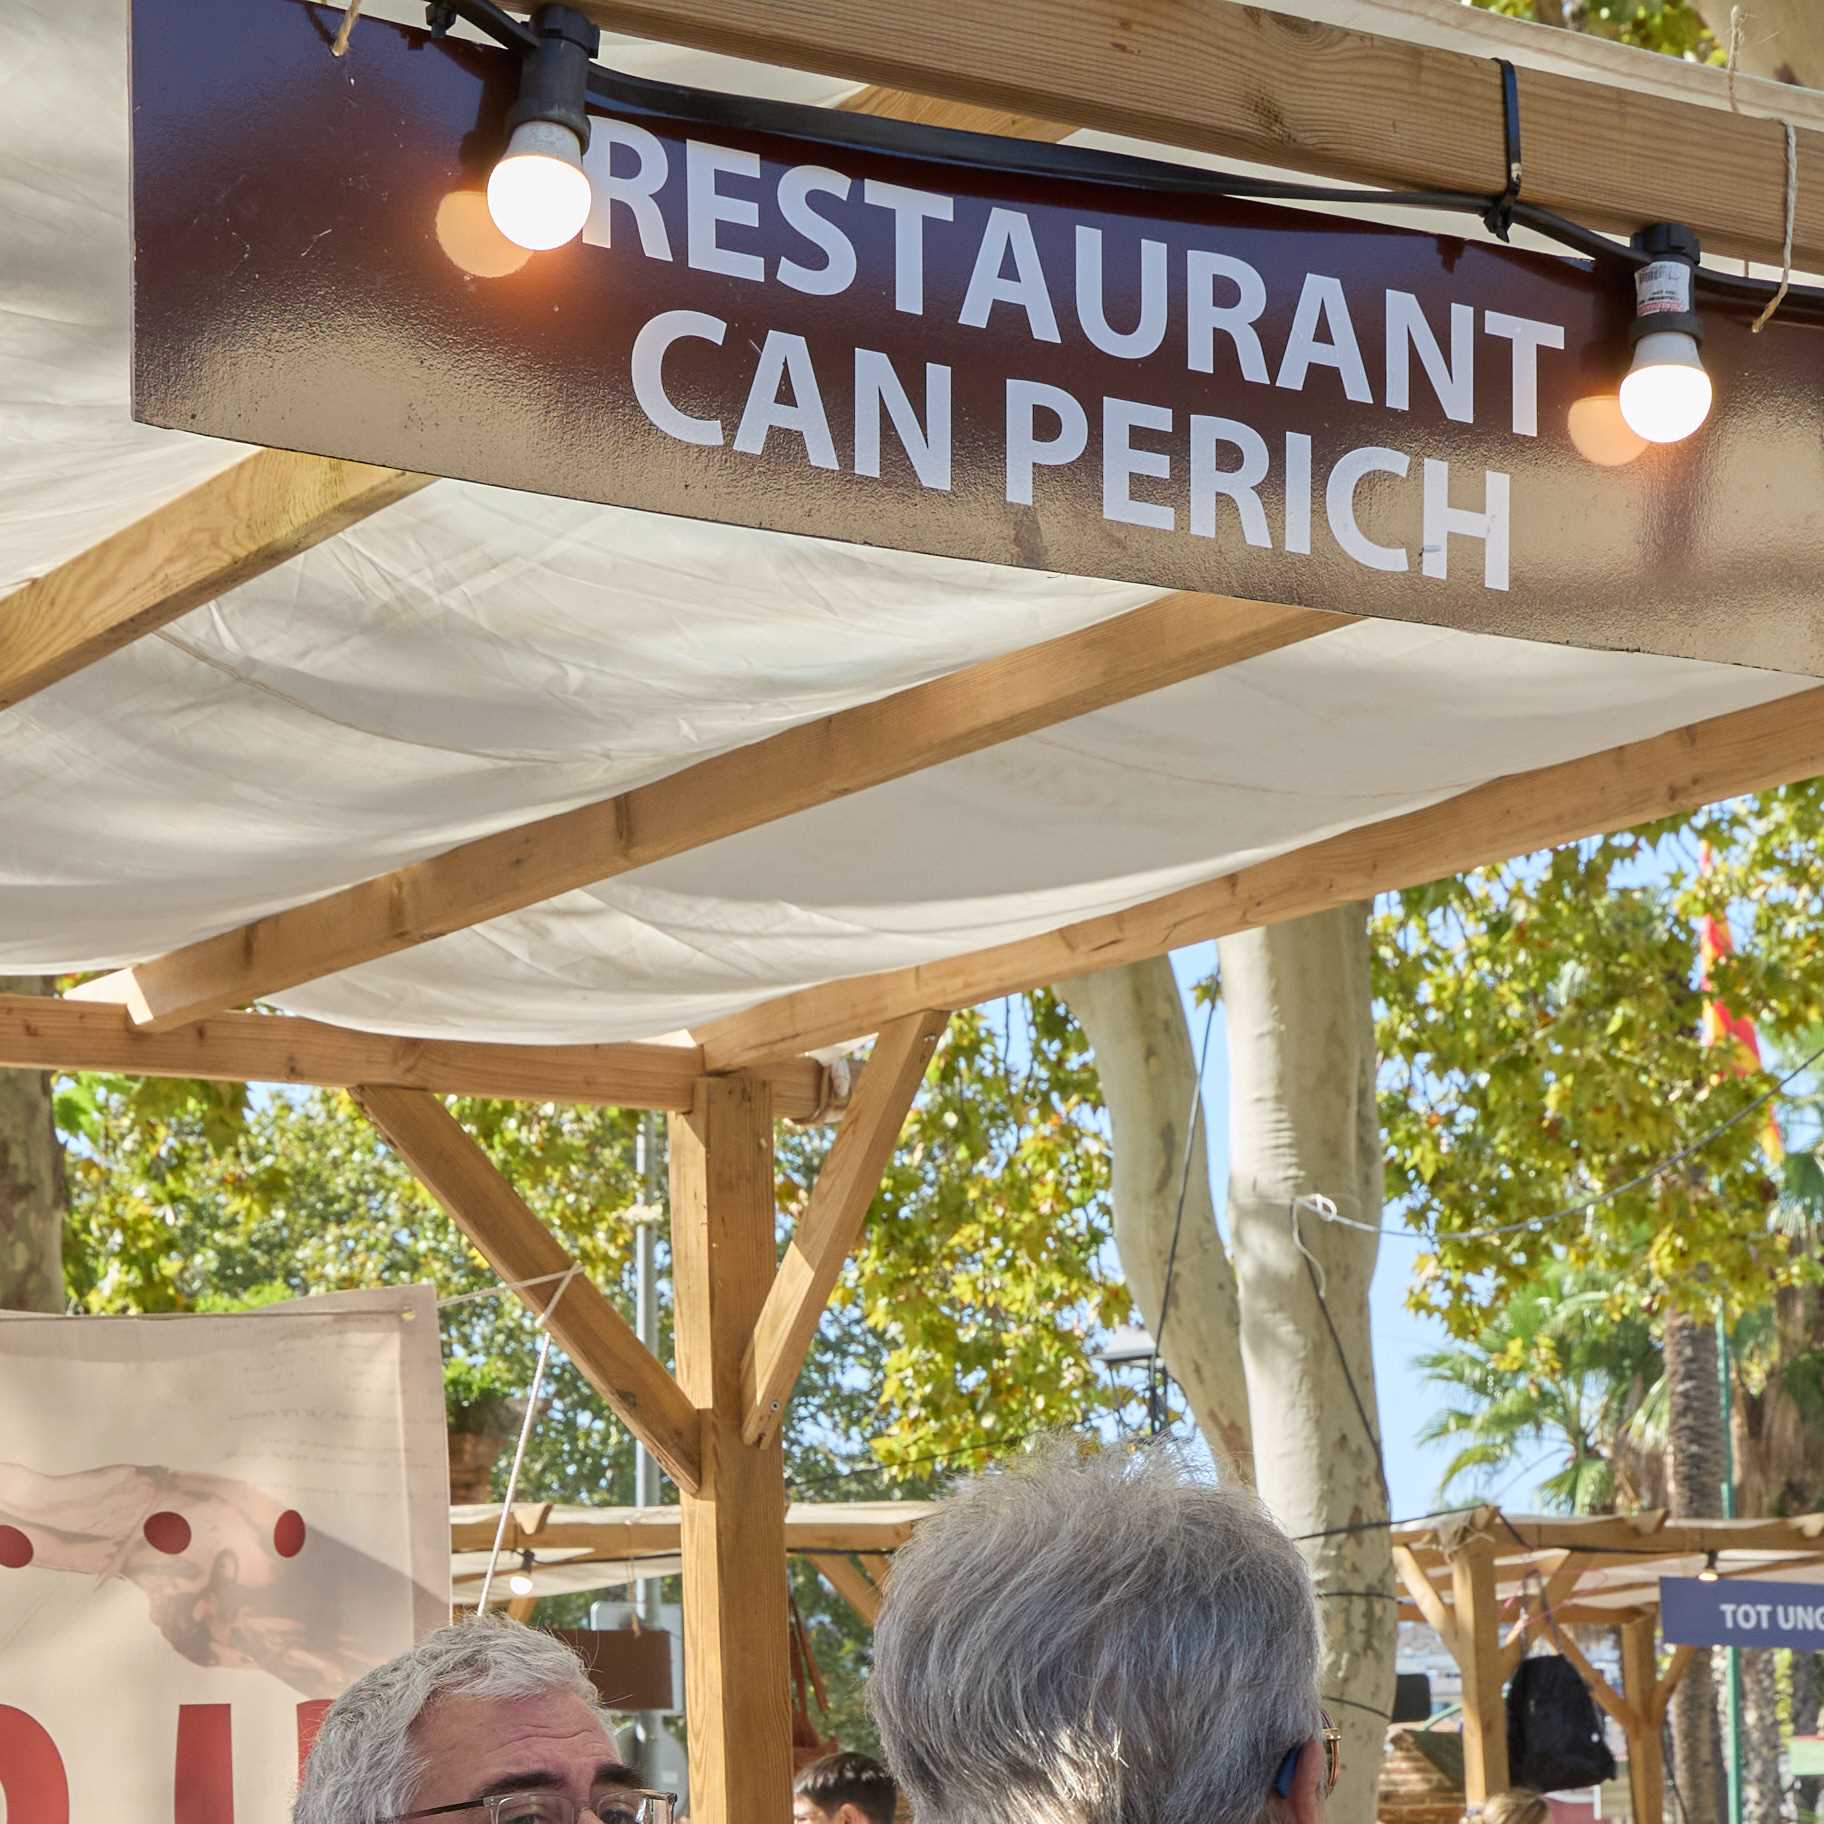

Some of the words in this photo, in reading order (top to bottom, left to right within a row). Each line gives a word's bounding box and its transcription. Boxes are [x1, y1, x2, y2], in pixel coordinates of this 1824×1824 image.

[585, 116, 1565, 436] RESTAURANT
[629, 308, 954, 493] CAN
[1005, 377, 1513, 593] PERICH
[1720, 1604, 1772, 1629] TOT
